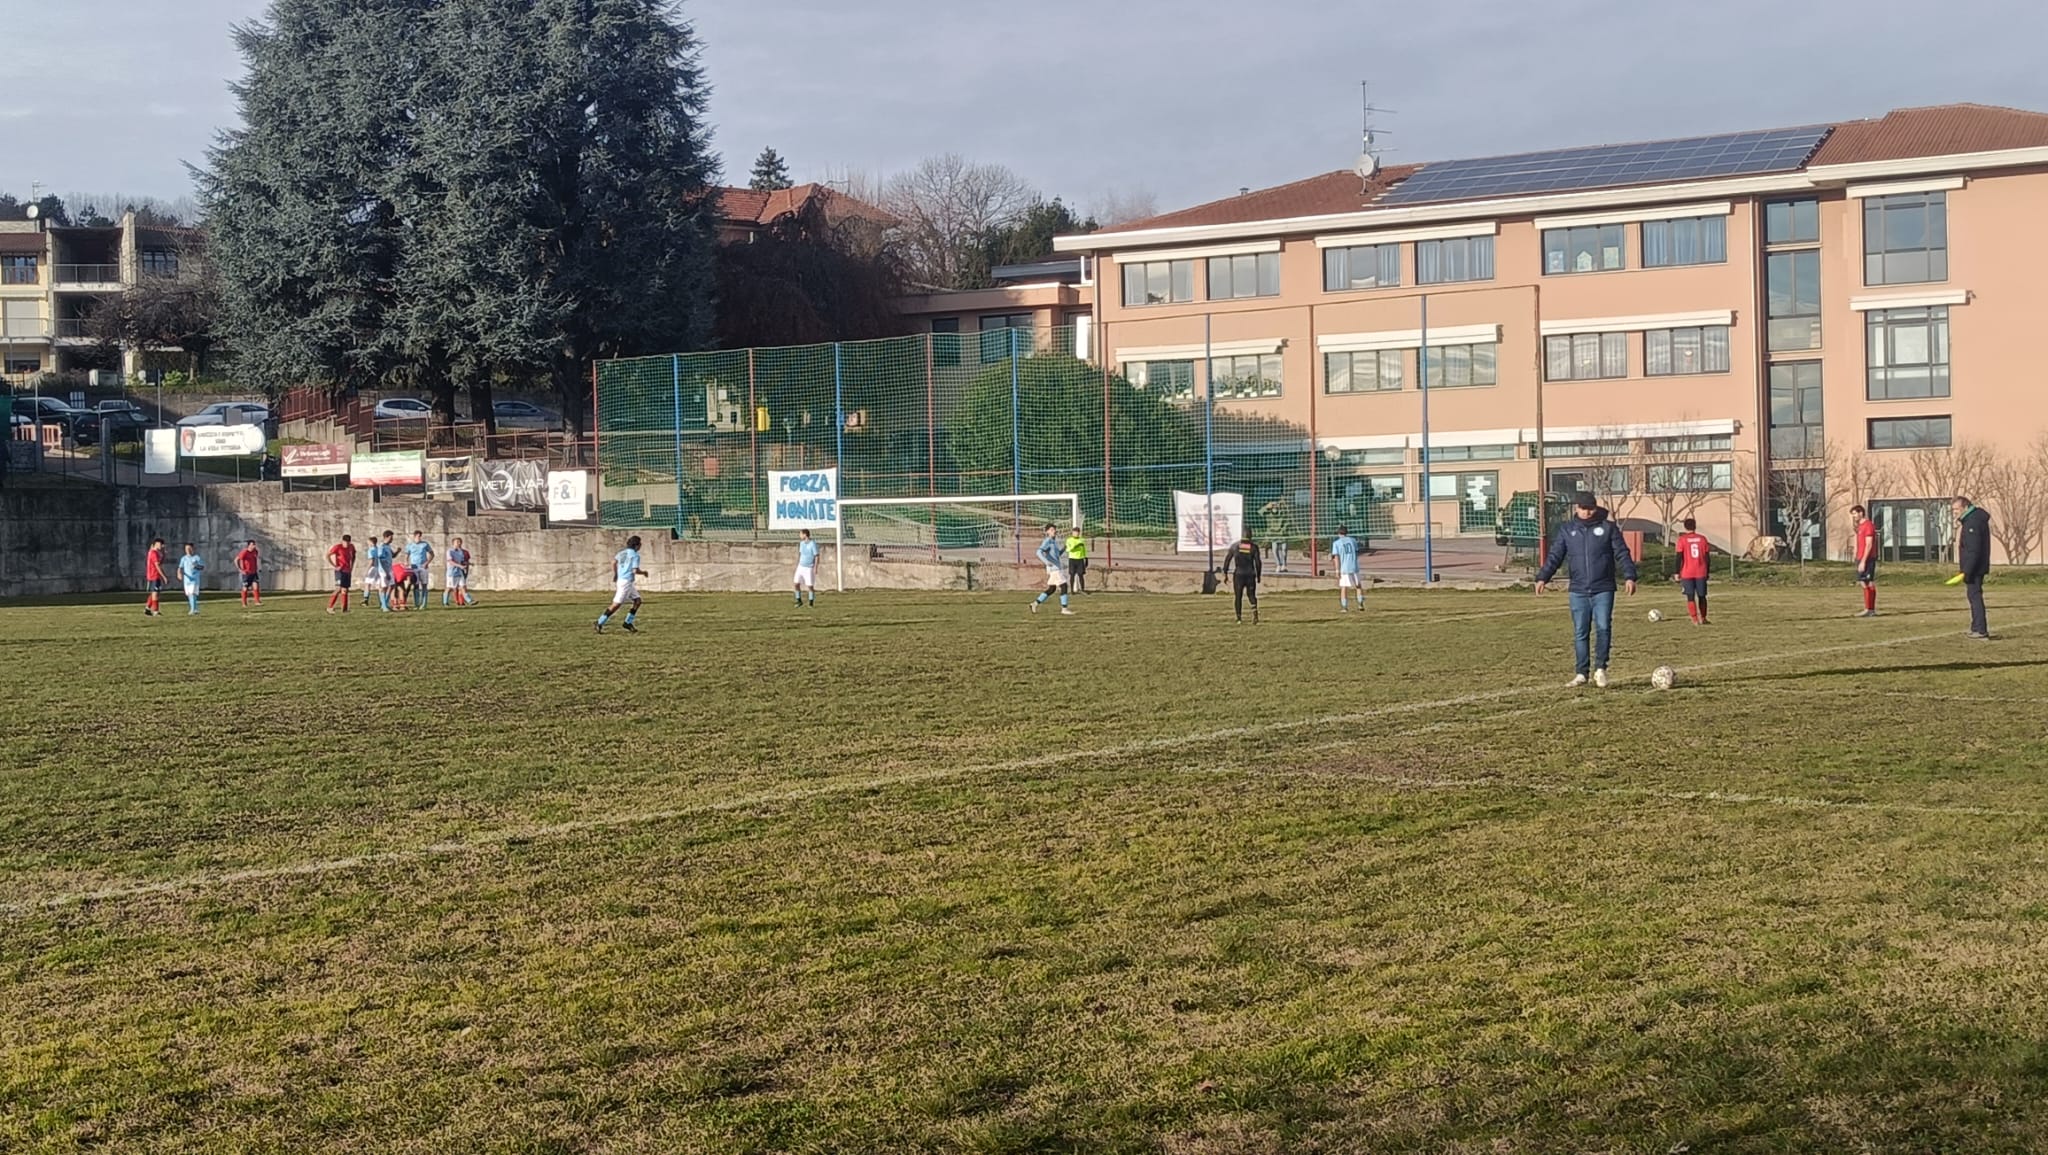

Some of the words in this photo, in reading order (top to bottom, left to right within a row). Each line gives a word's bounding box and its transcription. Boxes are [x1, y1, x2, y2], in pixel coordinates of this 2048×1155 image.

[780, 473, 830, 493] FORZA
[776, 498, 836, 521] MONATE
[1690, 543, 1699, 559] 6
